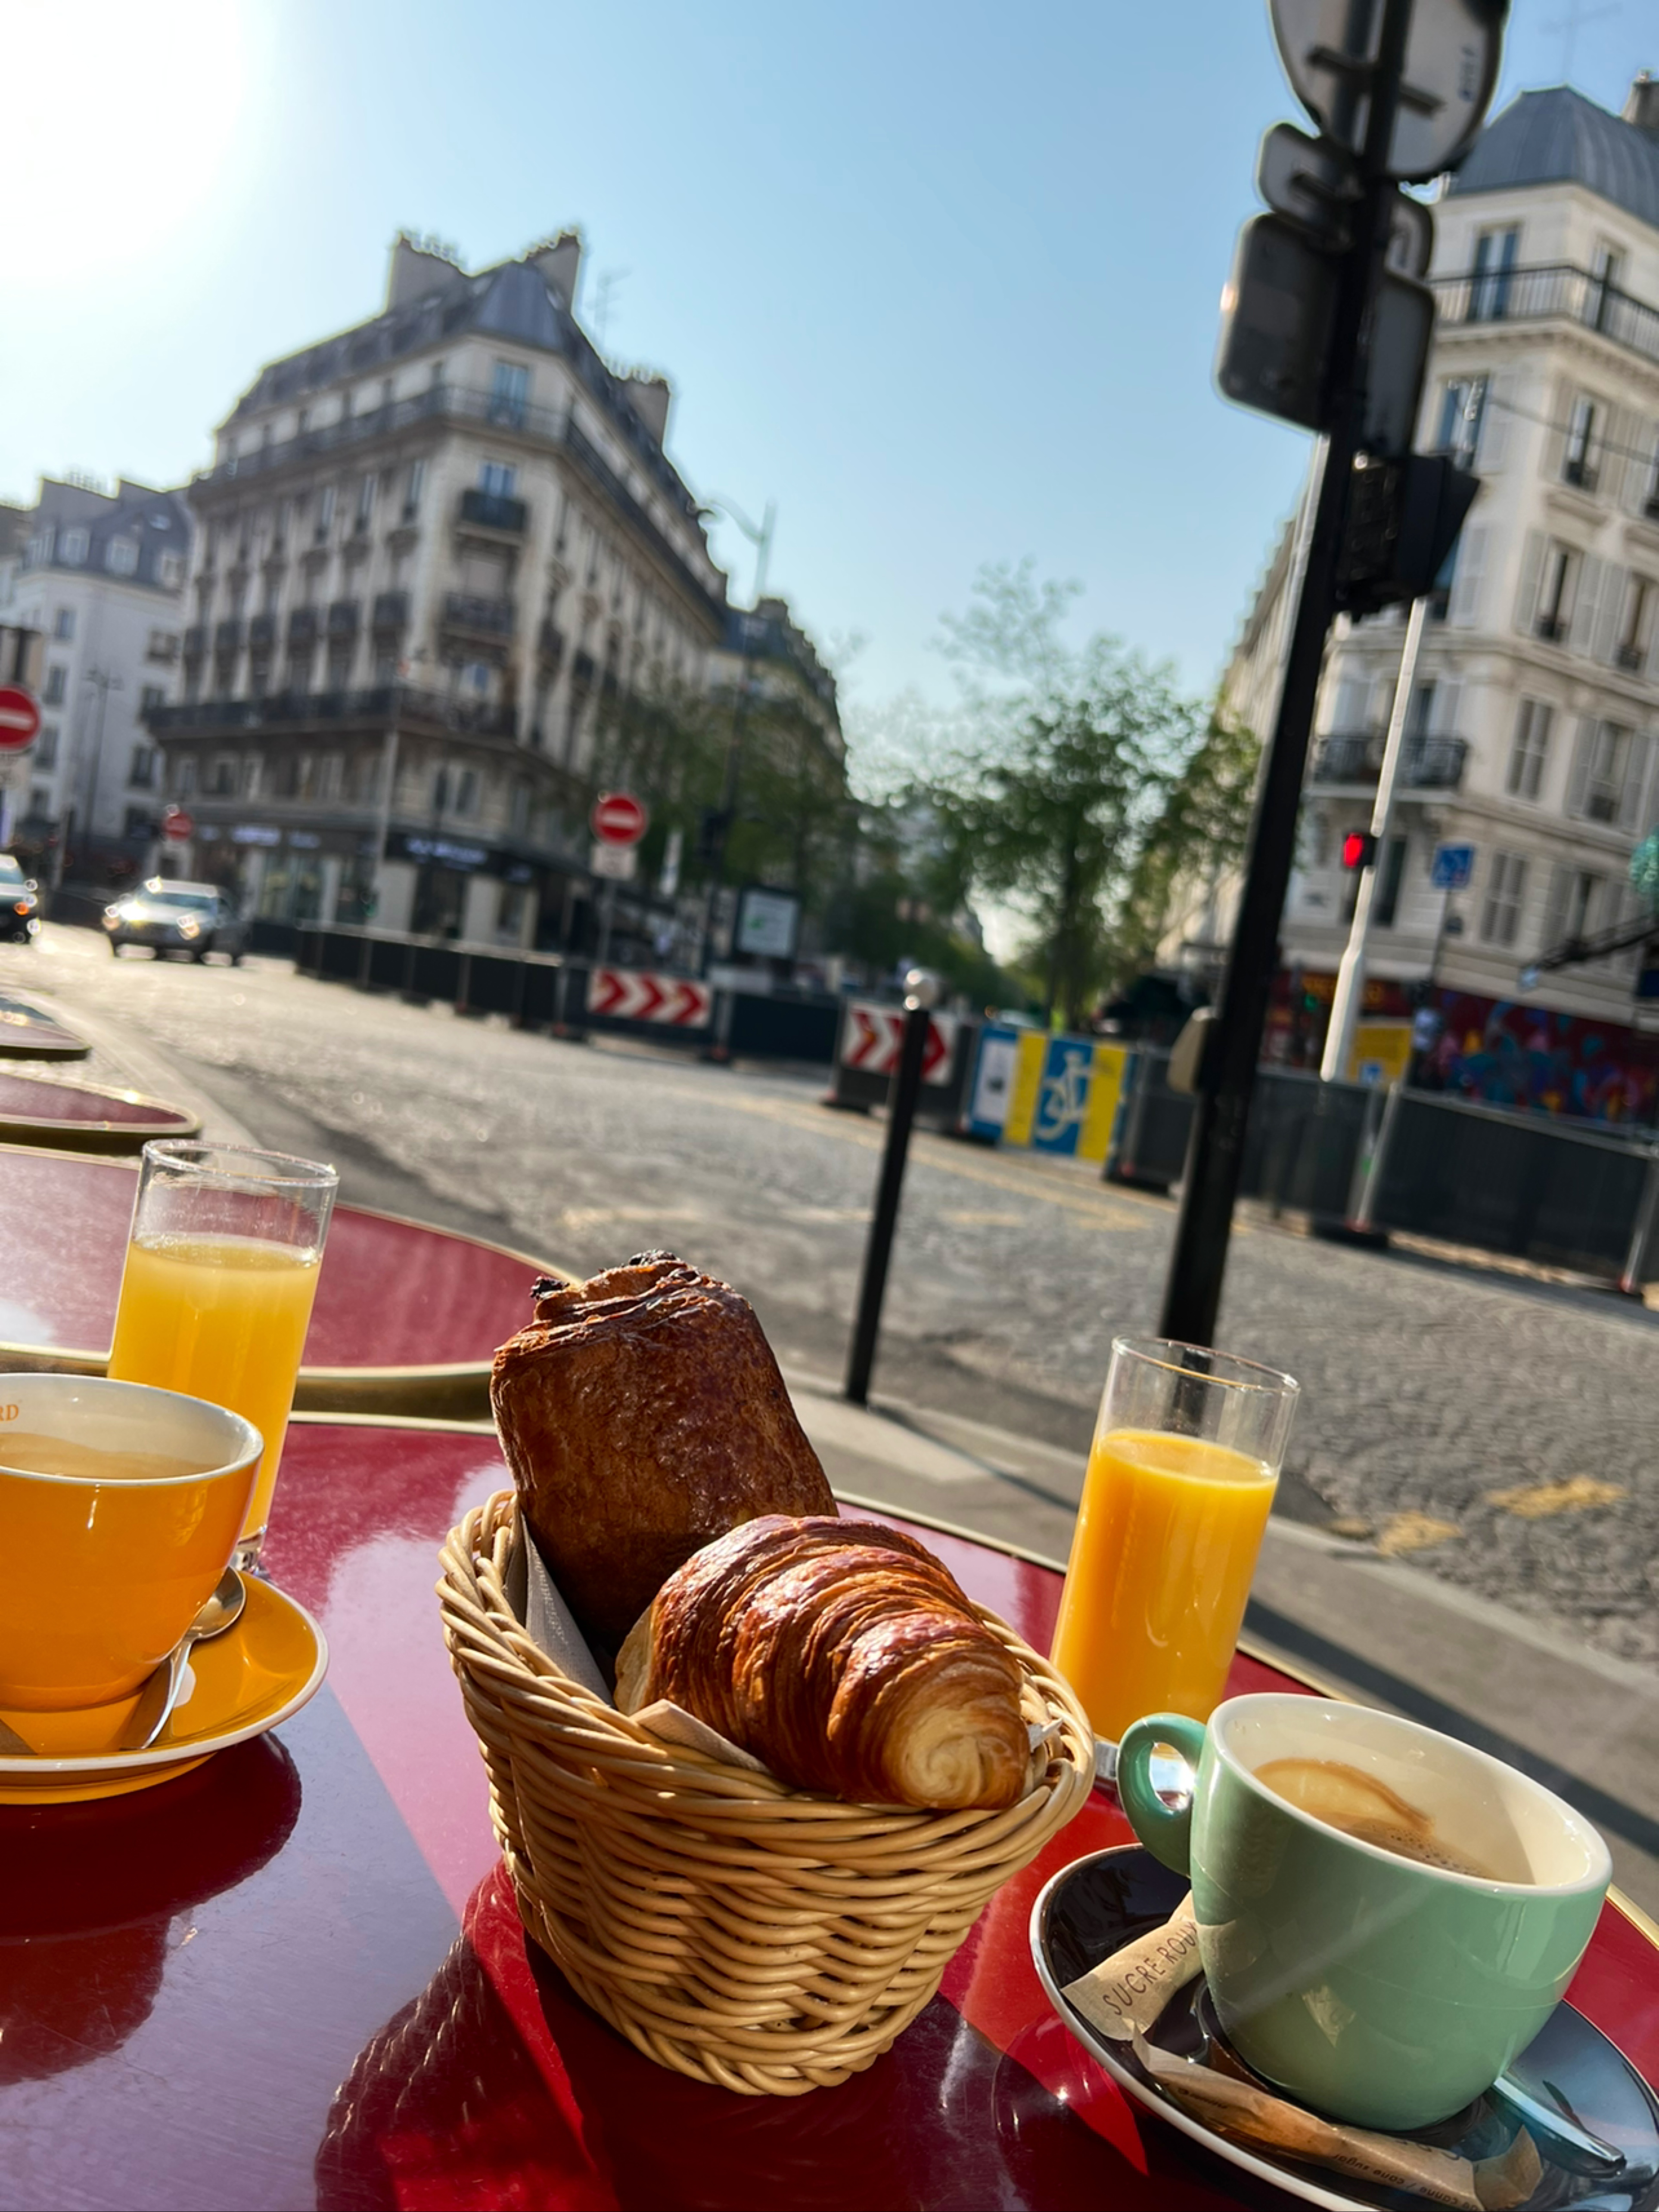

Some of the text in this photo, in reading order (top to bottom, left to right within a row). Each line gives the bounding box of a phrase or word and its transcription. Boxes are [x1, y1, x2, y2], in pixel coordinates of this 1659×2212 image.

[1103, 1958, 1165, 2015] SUCRE
[1334, 2154, 1370, 2171] sugar
[1373, 2169, 1405, 2184] cane
[1421, 2187, 1457, 2205] canne
